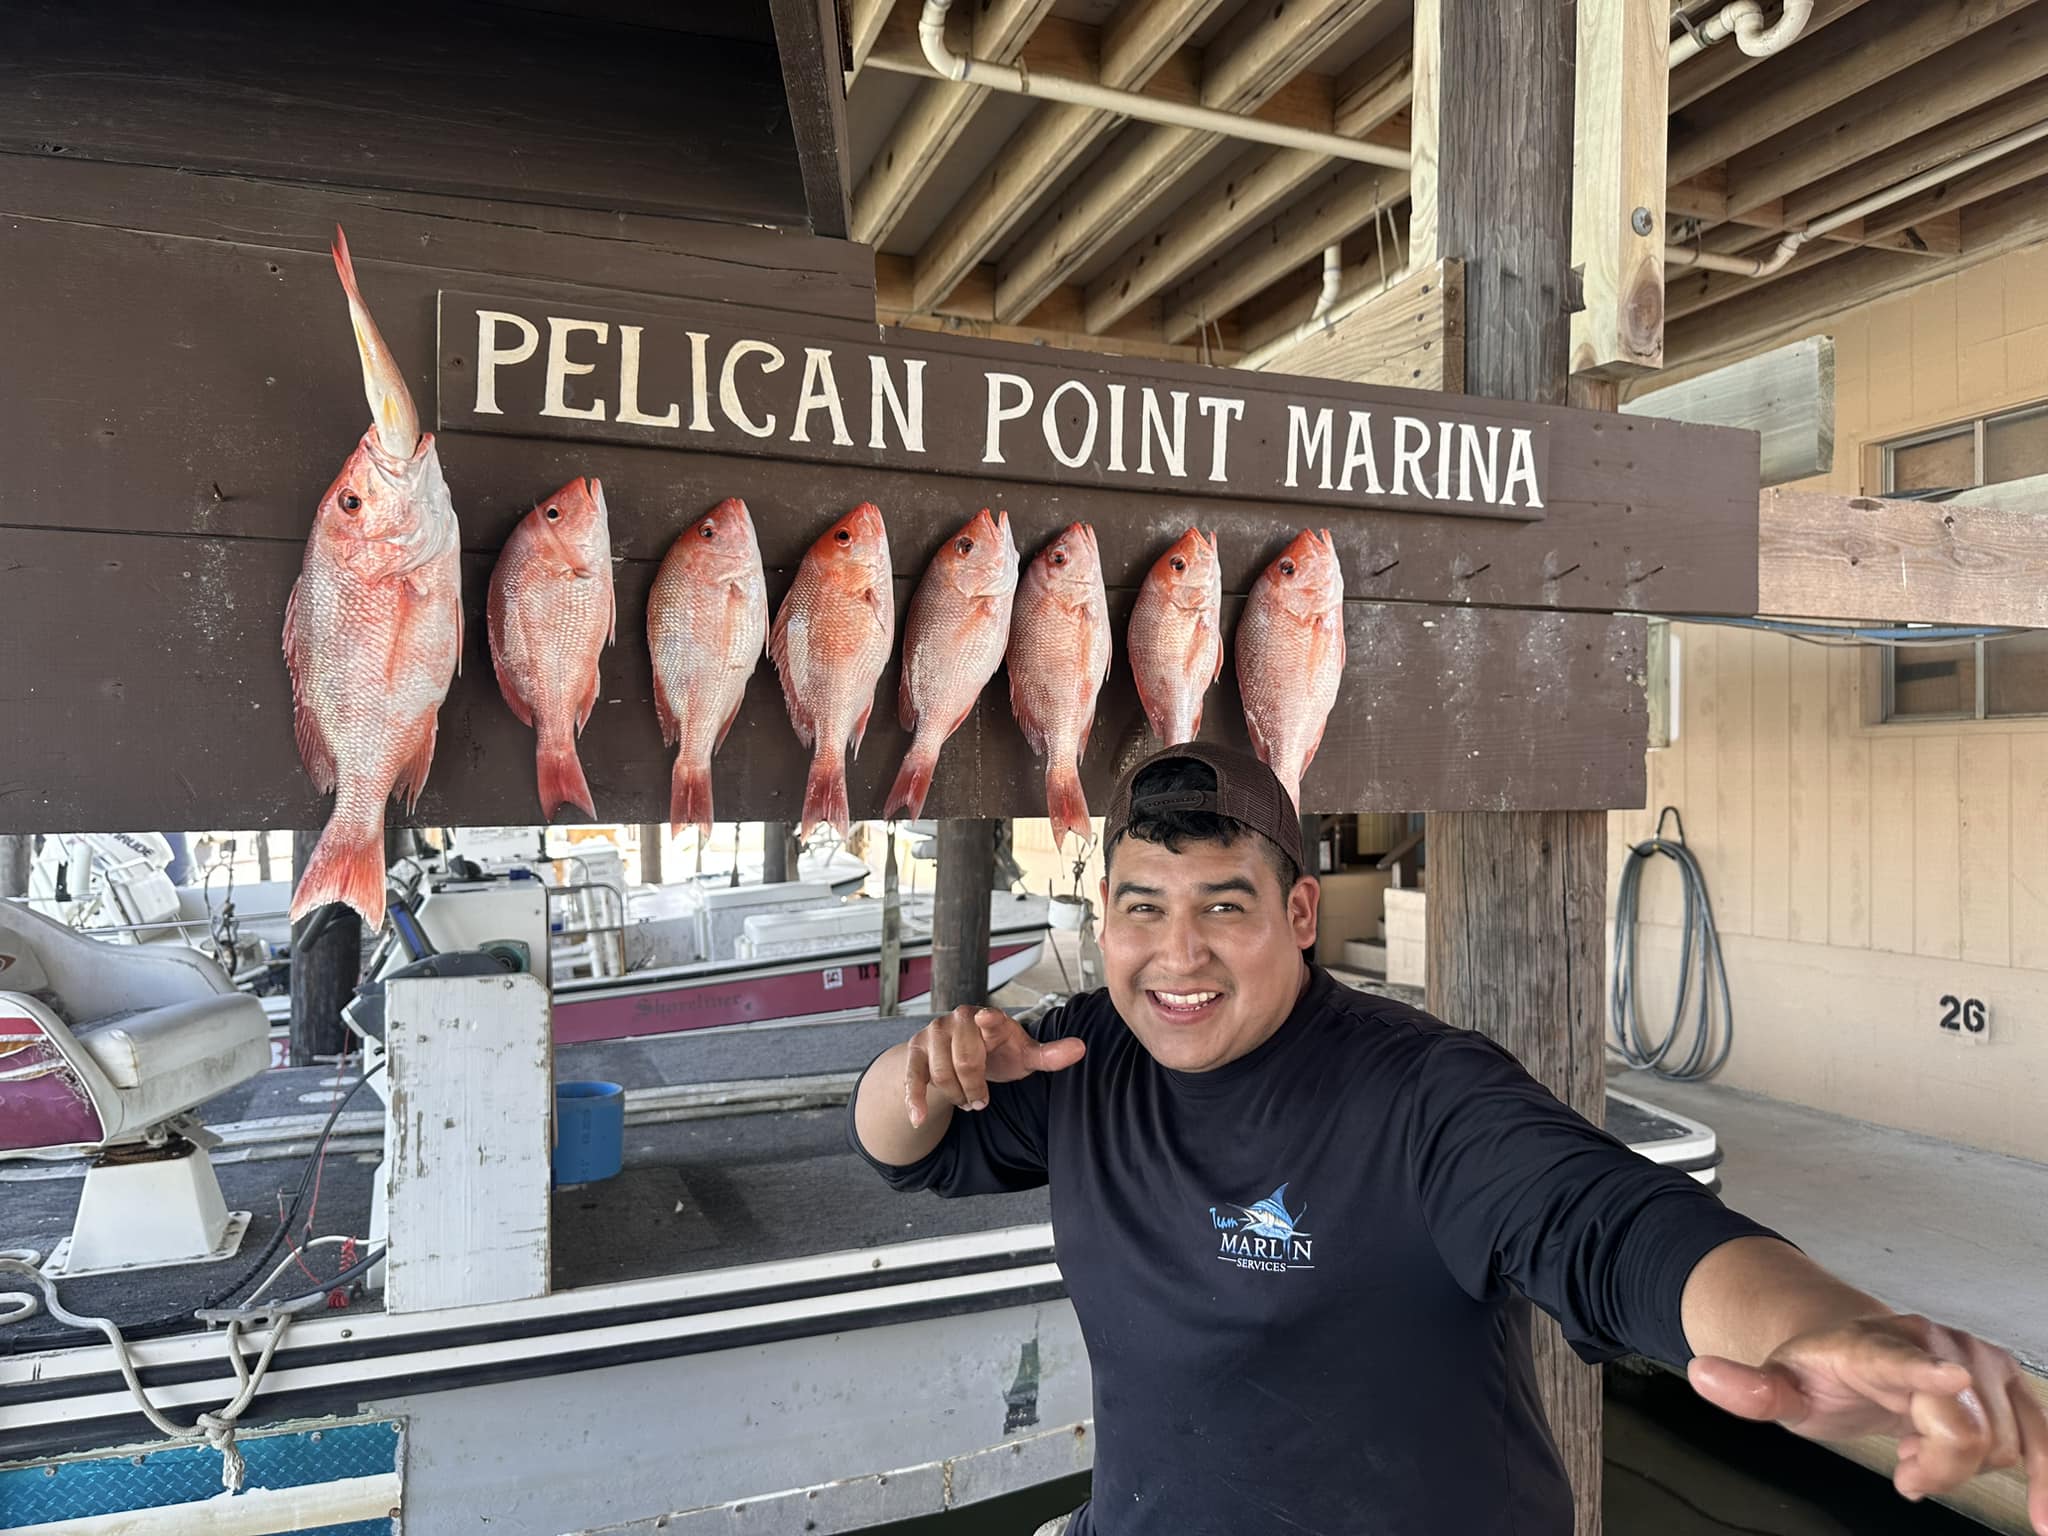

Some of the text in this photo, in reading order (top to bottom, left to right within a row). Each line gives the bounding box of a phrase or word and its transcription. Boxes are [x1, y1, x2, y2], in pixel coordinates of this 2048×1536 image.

[473, 309, 1545, 509] PELICAN POINT MARINA
[1939, 995, 1986, 1032] 26
[1236, 1257, 1287, 1272] SERVICES
